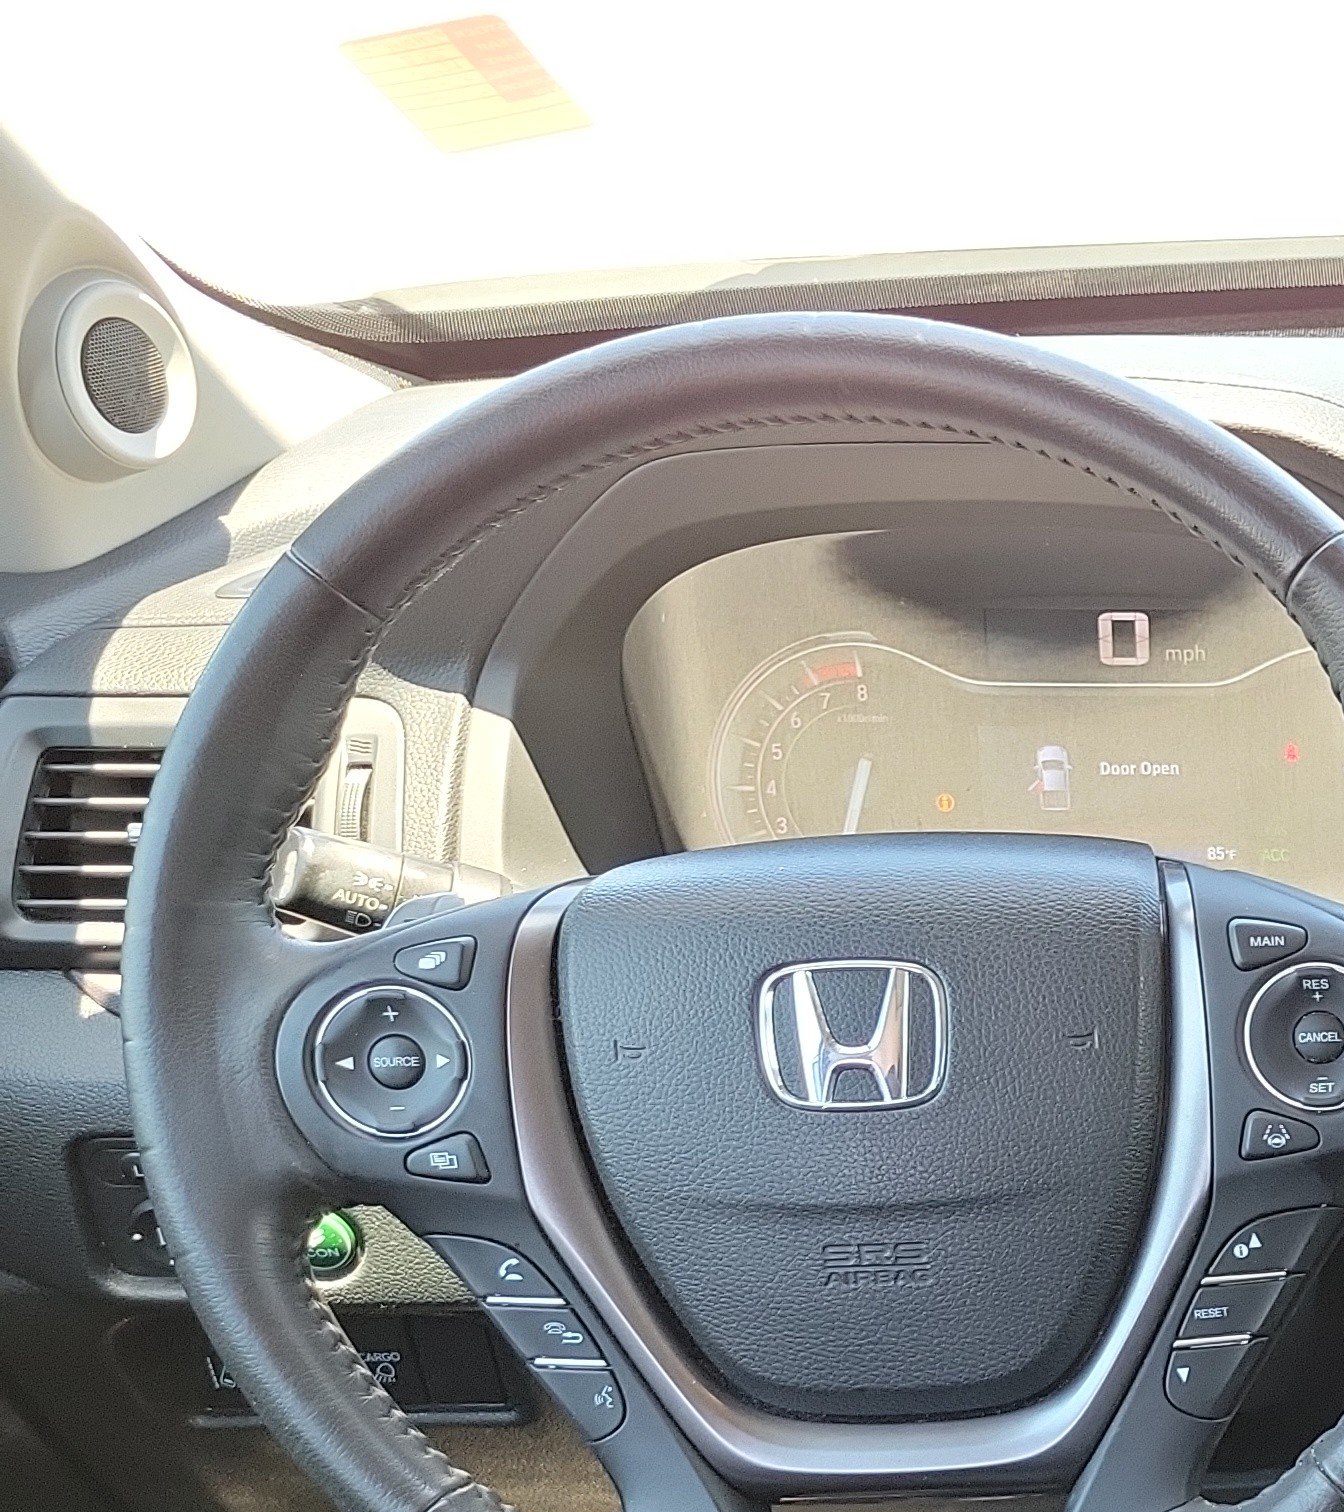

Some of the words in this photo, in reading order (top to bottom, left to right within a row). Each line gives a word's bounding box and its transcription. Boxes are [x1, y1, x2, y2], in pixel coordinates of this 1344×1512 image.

[1098, 612, 1150, 666] 0
[1166, 644, 1206, 665] mph
[820, 692, 831, 709] 7
[857, 684, 868, 701] 8
[791, 712, 801, 728] 6
[771, 743, 783, 760] 5
[1100, 761, 1136, 776] Door
[1141, 761, 1180, 777] Open
[766, 780, 776, 797] 4
[776, 817, 788, 834] 3
[331, 888, 380, 911] AUTO
[1250, 936, 1285, 947] MAIN
[1302, 979, 1330, 990] RES
[1298, 1032, 1342, 1043] CANCEL
[373, 1055, 420, 1068] SOURCE
[1309, 1082, 1335, 1093] SET
[307, 1247, 340, 1258] CON
[1194, 1306, 1228, 1319] RESET
